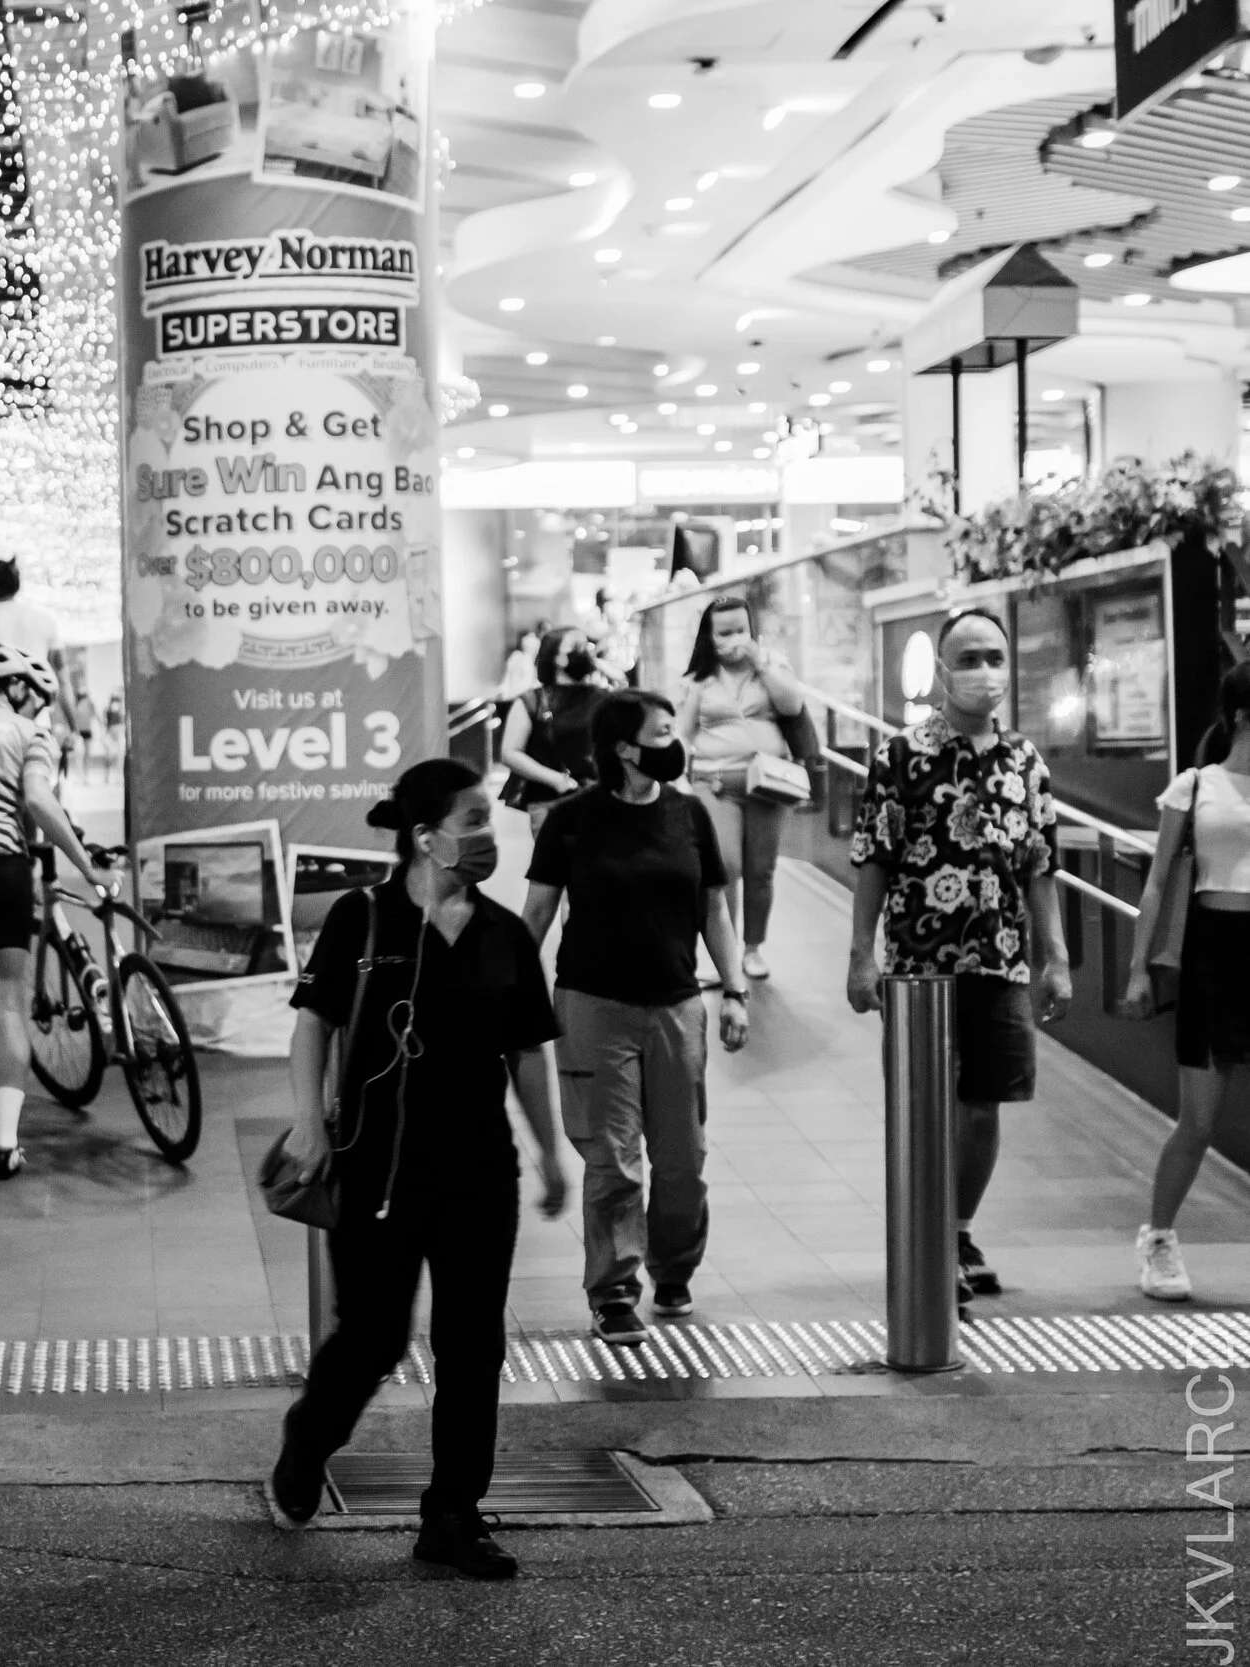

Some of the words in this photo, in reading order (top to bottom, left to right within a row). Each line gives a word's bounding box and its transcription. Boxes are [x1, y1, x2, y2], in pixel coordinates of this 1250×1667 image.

[145, 246, 265, 281] Harvey
[278, 235, 416, 275] Norman
[166, 309, 397, 347] SUPERSTORE
[183, 415, 272, 446] Shop
[285, 411, 308, 438] &
[323, 411, 383, 438] Get
[136, 462, 209, 503] Sure
[215, 451, 307, 495] Win
[316, 464, 384, 497] Ang
[166, 505, 294, 537] Scratch
[307, 504, 404, 532] Cards
[184, 543, 399, 592] $800,000
[185, 601, 205, 619] to
[212, 598, 240, 618] be
[248, 596, 316, 621] given
[325, 599, 390, 619] away.
[233, 688, 287, 710] Visit
[289, 691, 315, 709] us
[319, 688, 344, 709] at
[178, 712, 347, 772] Level
[362, 710, 402, 769] 3
[178, 782, 205, 801] for
[206, 784, 254, 801] more
[258, 781, 325, 801] festive
